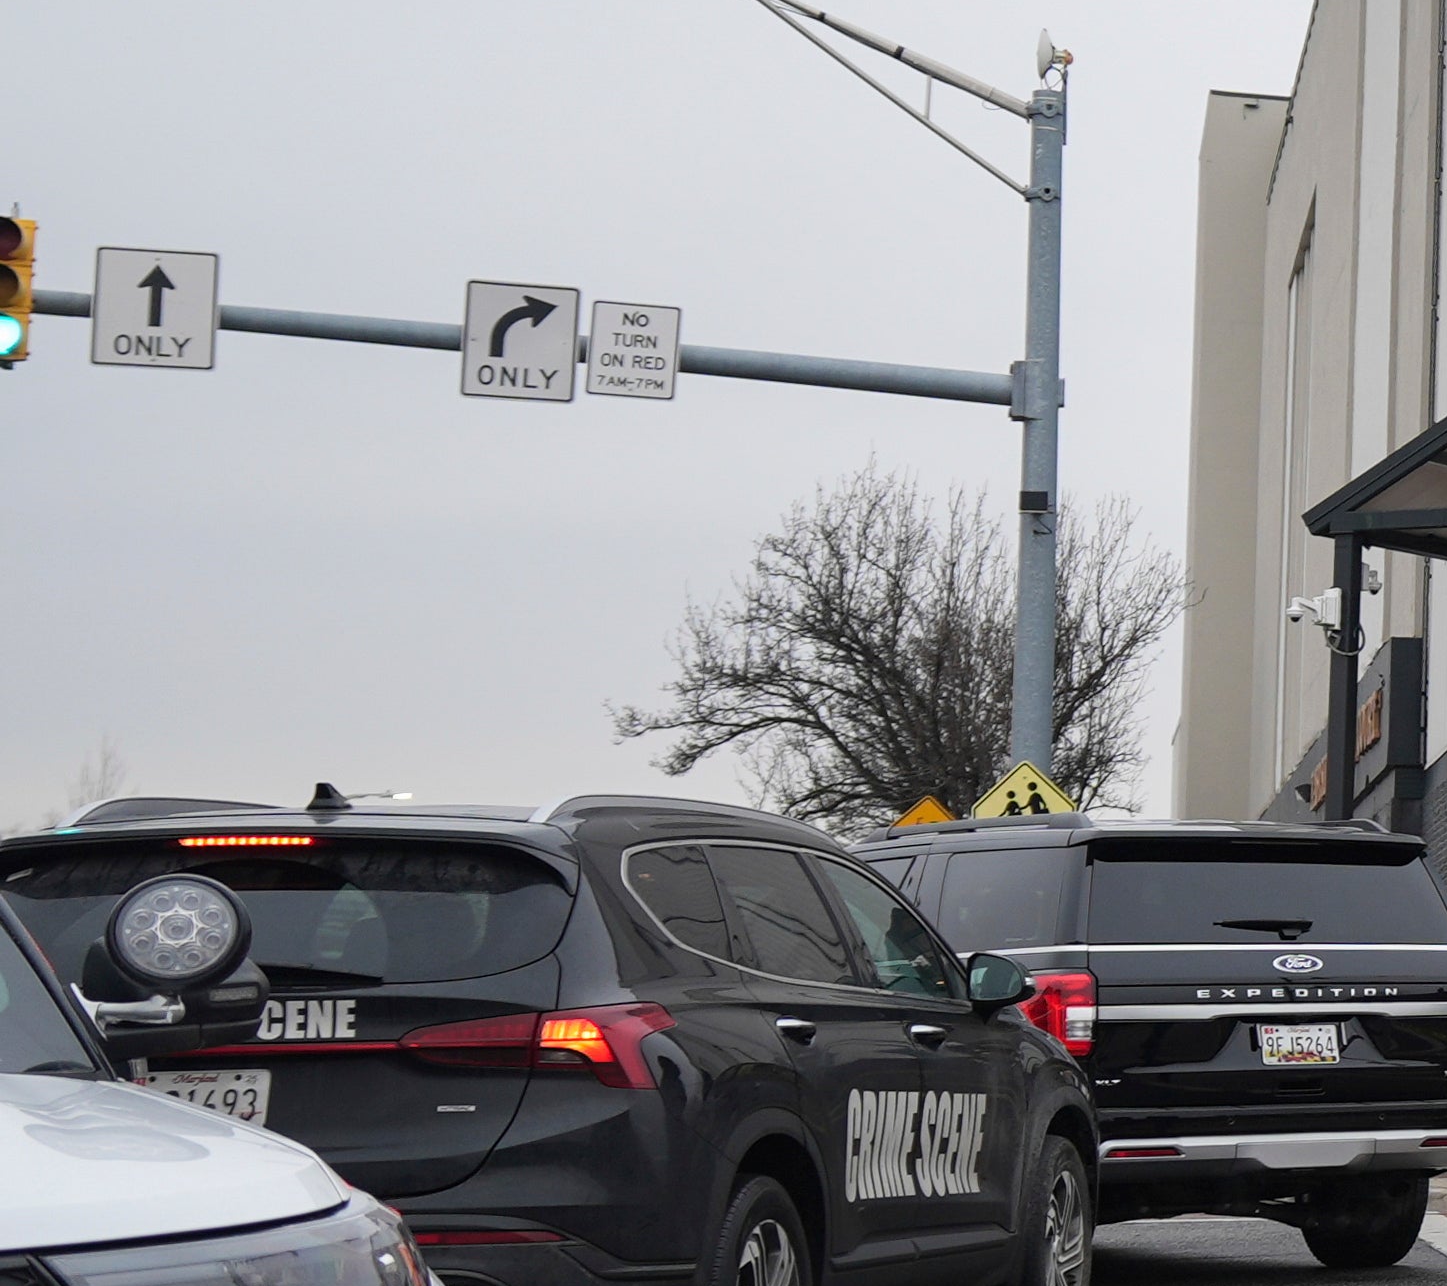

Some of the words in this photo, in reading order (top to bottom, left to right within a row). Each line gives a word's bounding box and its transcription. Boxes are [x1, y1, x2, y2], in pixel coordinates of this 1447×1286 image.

[621, 312, 649, 328] NO
[113, 333, 192, 358] ONLY
[612, 332, 657, 349] TURN
[600, 353, 624, 368] ON
[631, 355, 666, 371] RED
[477, 364, 559, 390] ONLY
[596, 374, 665, 391] 7AM-7PM
[1286, 956, 1312, 969] Ford
[1196, 987, 1398, 999] EXPEDITION
[256, 999, 357, 1040] CENE
[845, 1088, 920, 1203] CRIME
[915, 1090, 988, 1198] SCENE
